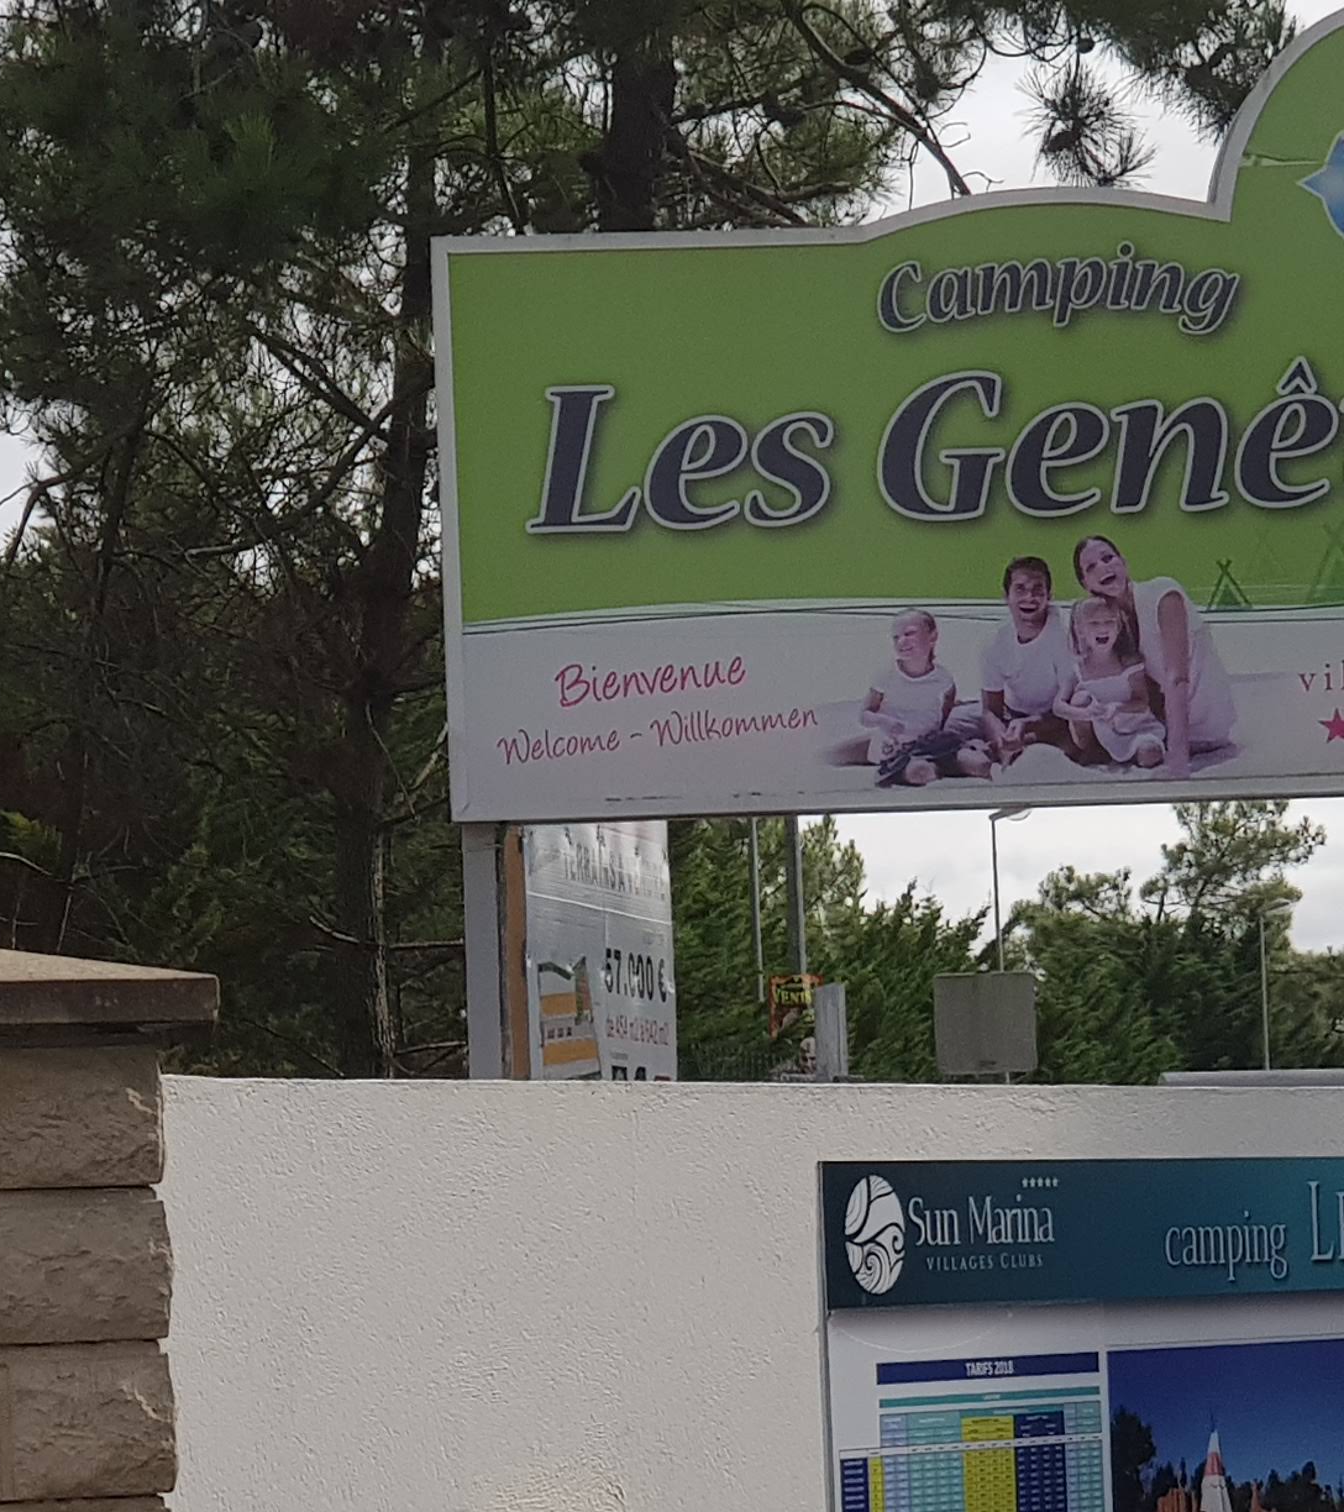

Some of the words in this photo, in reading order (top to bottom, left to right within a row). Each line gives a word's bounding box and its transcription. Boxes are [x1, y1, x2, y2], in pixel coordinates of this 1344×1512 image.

[878, 242, 1242, 334] Camping
[525, 384, 836, 533] Les
[554, 652, 747, 707] Bienvenue
[497, 725, 619, 765] Welcome
[649, 703, 818, 747] Willkommen
[907, 1196, 960, 1248] Sun
[969, 1194, 1055, 1246] Marina
[1165, 1211, 1288, 1281] camping
[926, 1254, 992, 1271] VILLAGES
[966, 1361, 993, 1376] TARIFS
